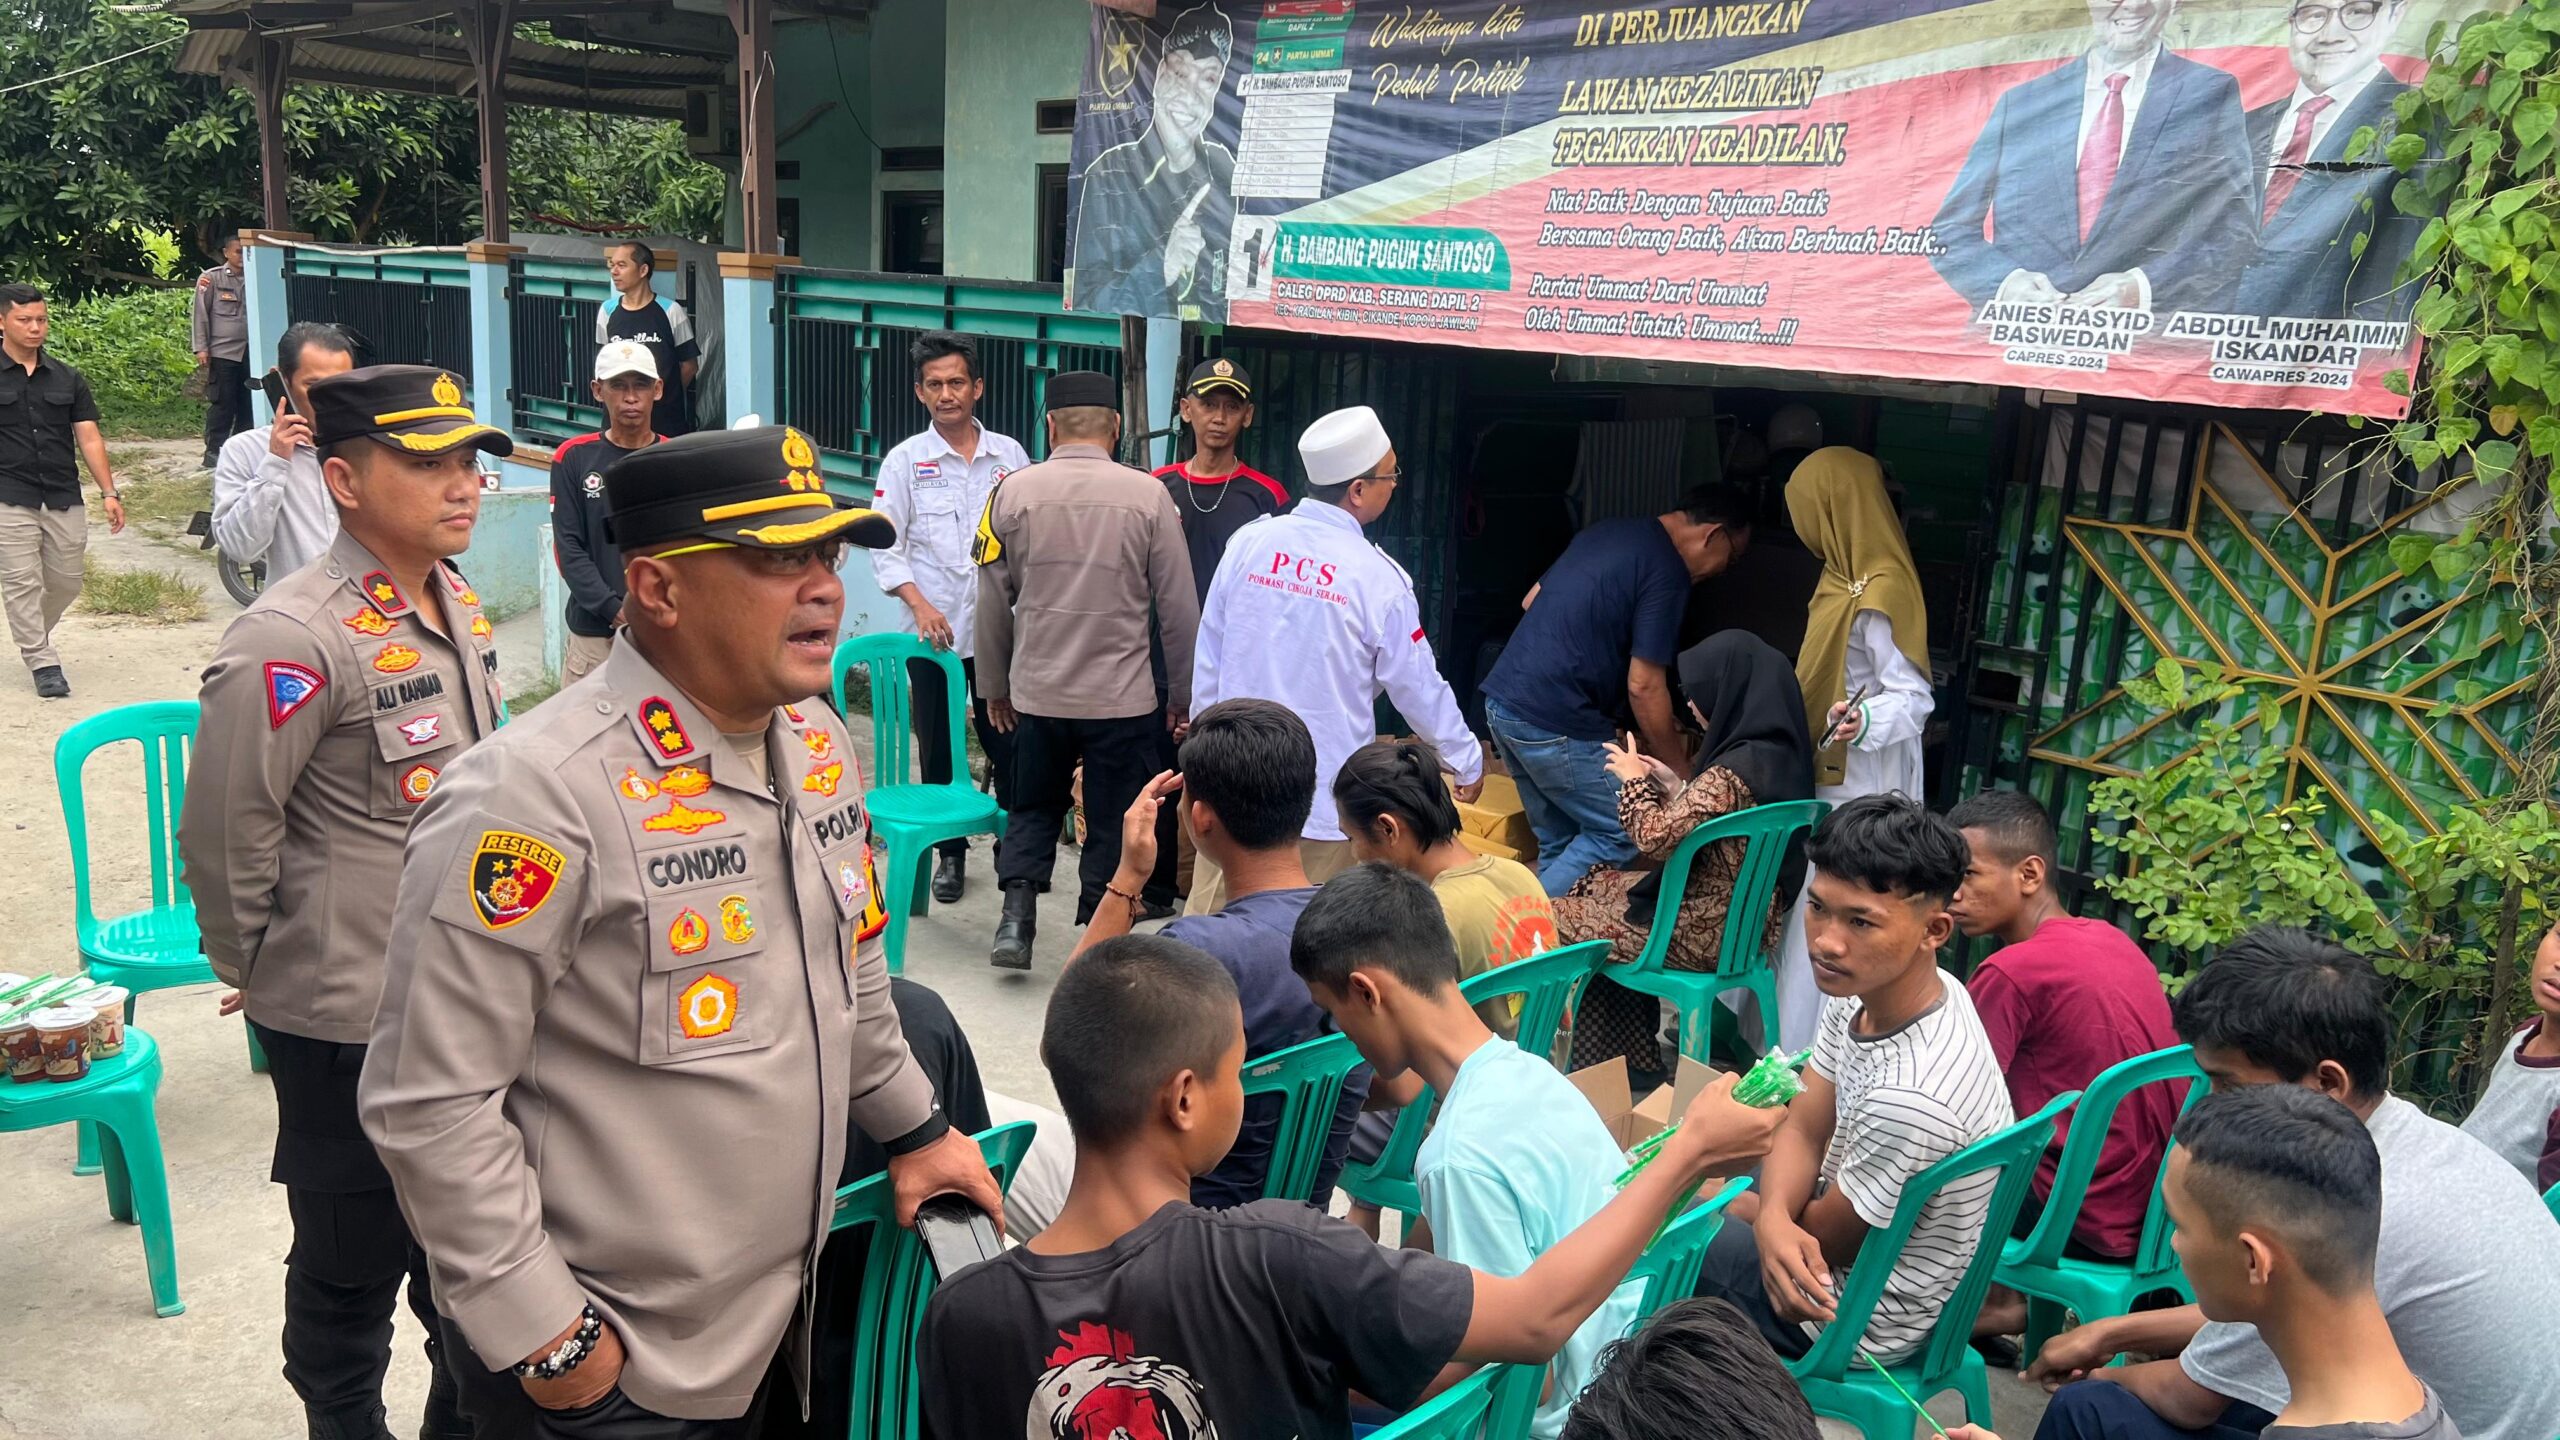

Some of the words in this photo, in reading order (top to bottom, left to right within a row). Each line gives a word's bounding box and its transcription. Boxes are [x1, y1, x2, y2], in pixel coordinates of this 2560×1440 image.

[1288, 23, 1307, 32] DAPIL
[1308, 23, 1315, 31] 2
[1369, 5, 1477, 56] Waktunya
[1481, 4, 1525, 40] kita
[1573, 14, 1605, 46] DI
[1606, 0, 1811, 45] PERJUANGKAN
[1256, 51, 1269, 64] 24
[1286, 51, 1309, 60] PARTAI
[1261, 78, 1291, 90] BAMBANG
[1292, 77, 1314, 88] PUGUH
[1316, 75, 1348, 88] SANTOSO
[1371, 62, 1440, 106] Peduli
[1450, 56, 1530, 104] Politik
[1557, 77, 1653, 114] LAWAN
[1650, 67, 1823, 112] KEZALIMAN
[1553, 127, 1695, 166] TEGAKKAN
[1691, 124, 1848, 166] KEADILAN.
[1546, 188, 1584, 213] Niat
[1584, 189, 1628, 213] Baik
[1630, 189, 1700, 220] Dengan
[1707, 189, 1774, 221] Tujuan
[1777, 189, 1830, 216] Baik
[1281, 234, 1294, 263] H.
[1297, 235, 1365, 267] BAMBANG
[1367, 239, 1419, 271] PUGUH
[1422, 240, 1496, 274] SANTOSO
[1538, 222, 1613, 248] Bersama
[1617, 224, 1674, 256] Orang
[1675, 224, 1726, 256] Baik,
[1730, 225, 1784, 251] Akan
[1788, 226, 1877, 253] Berbuah
[1880, 227, 1948, 255] Baik..
[1243, 228, 1264, 288] 1
[1277, 282, 1313, 300] CALEG
[1315, 285, 1347, 302] DPRD
[1349, 287, 1376, 304] KAB.
[1379, 288, 1427, 307] SERANG
[1430, 292, 1467, 310] DAPIL
[1470, 294, 1481, 311] 2
[1529, 273, 1582, 298] Partai
[1586, 275, 1650, 302] Ummat
[1651, 278, 1695, 304] Dari
[1698, 280, 1768, 306] Ummat
[1336, 308, 1360, 325] KIBIN,
[1362, 310, 1400, 328] CIKANDE,
[1402, 313, 1428, 328] KOPO
[1438, 316, 1478, 331] JAWILAN
[1525, 306, 1562, 332] Oleh
[1566, 308, 1627, 335] Ummat
[1631, 311, 1686, 338] Untuk
[1690, 314, 1798, 345] Ummat...!!!
[1982, 303, 2052, 324] ANIES
[1993, 324, 2130, 350] BASWEDAN
[2170, 315, 2261, 339] ABDUL
[2269, 321, 2404, 346] MUHAIMIN
[2006, 350, 2065, 366] CAPRES
[2069, 355, 2103, 369] 2024
[2216, 341, 2357, 366] ISKANDAR
[2213, 367, 2305, 383] CAWAPRES
[2309, 371, 2348, 386] 2024
[1248, 574, 1284, 589] PORMASI
[1288, 582, 1313, 596] CIKOJA
[1315, 589, 1348, 605] SERANG
[376, 686, 397, 711] ALI
[398, 673, 444, 705] RAHMAN
[814, 802, 863, 848] POLRI
[485, 835, 560, 870] RESERSE
[647, 843, 746, 888] CONDRO
